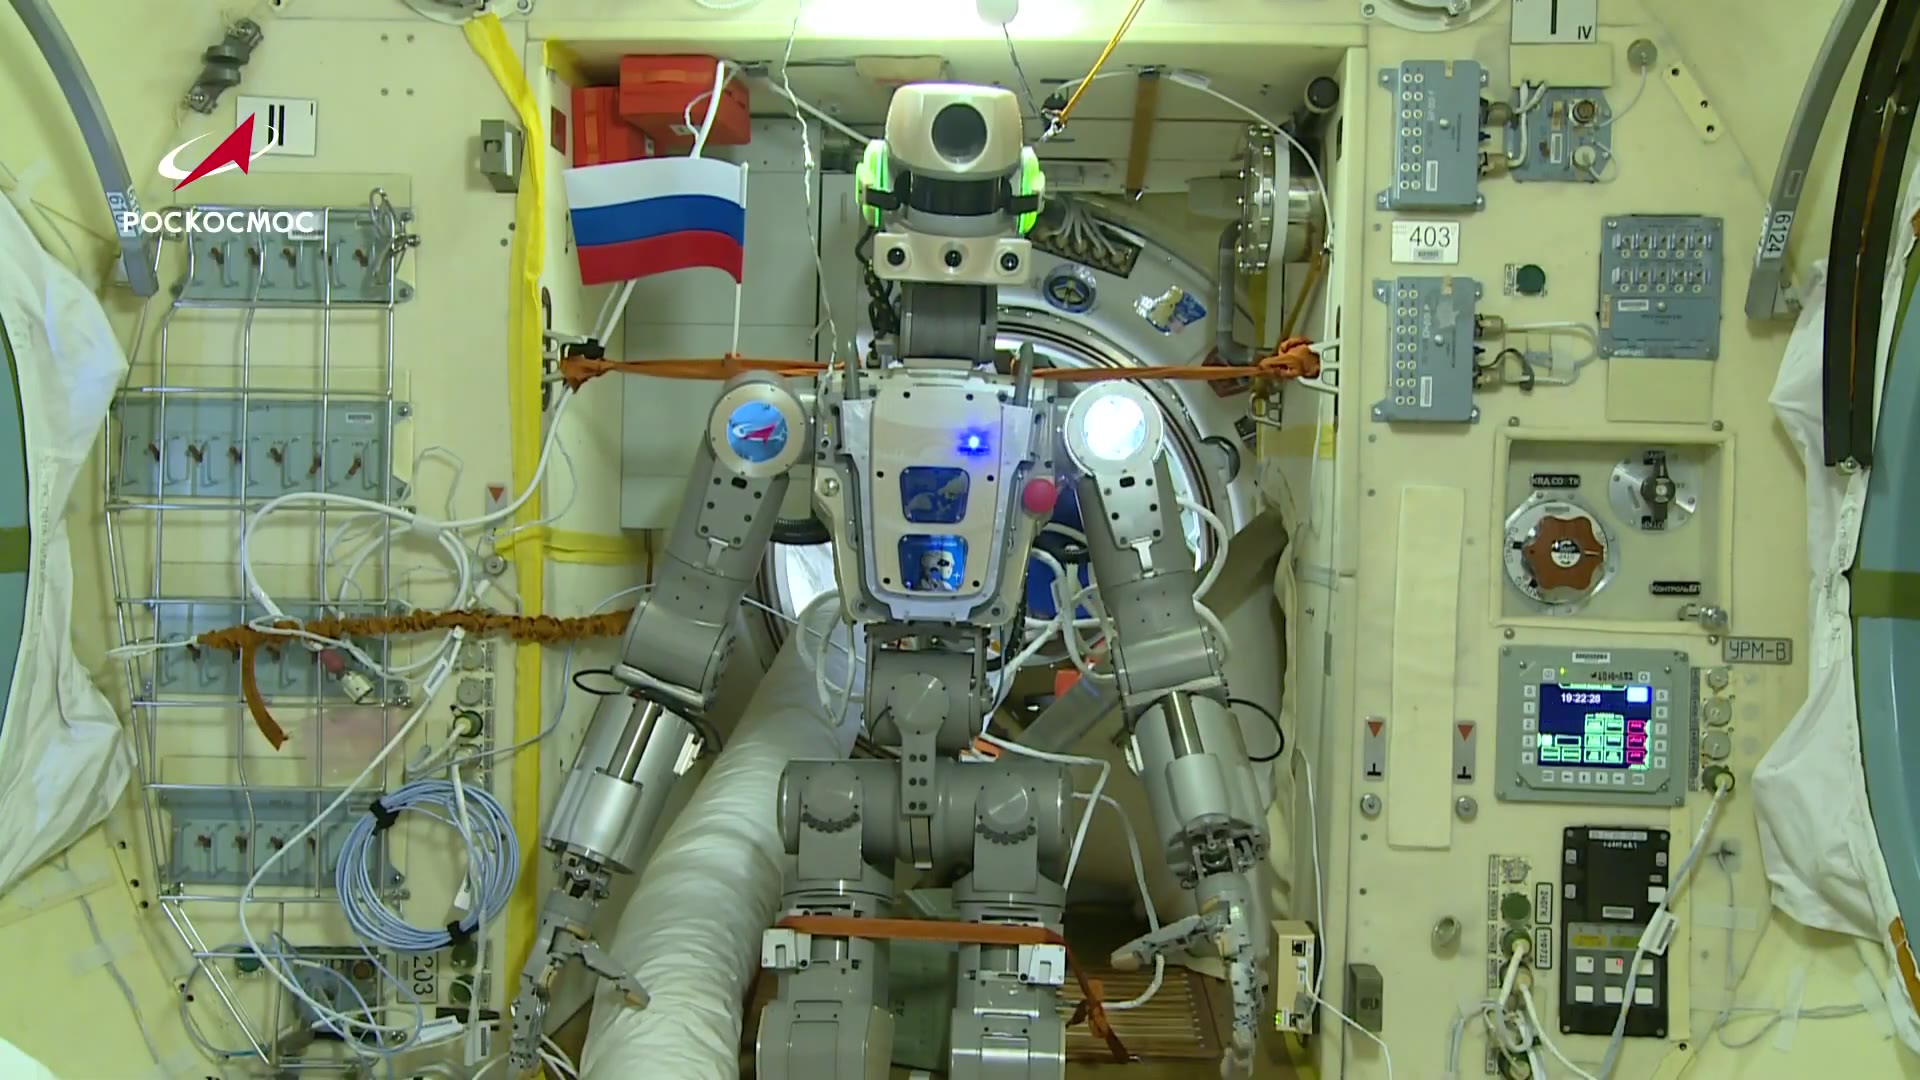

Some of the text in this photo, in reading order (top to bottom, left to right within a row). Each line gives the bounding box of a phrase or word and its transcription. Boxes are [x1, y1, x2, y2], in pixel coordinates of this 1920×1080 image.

[1577, 25, 1593, 40] IV
[1409, 225, 1450, 248] 403
[1766, 214, 1791, 253] 6124
[413, 955, 434, 995] 203
